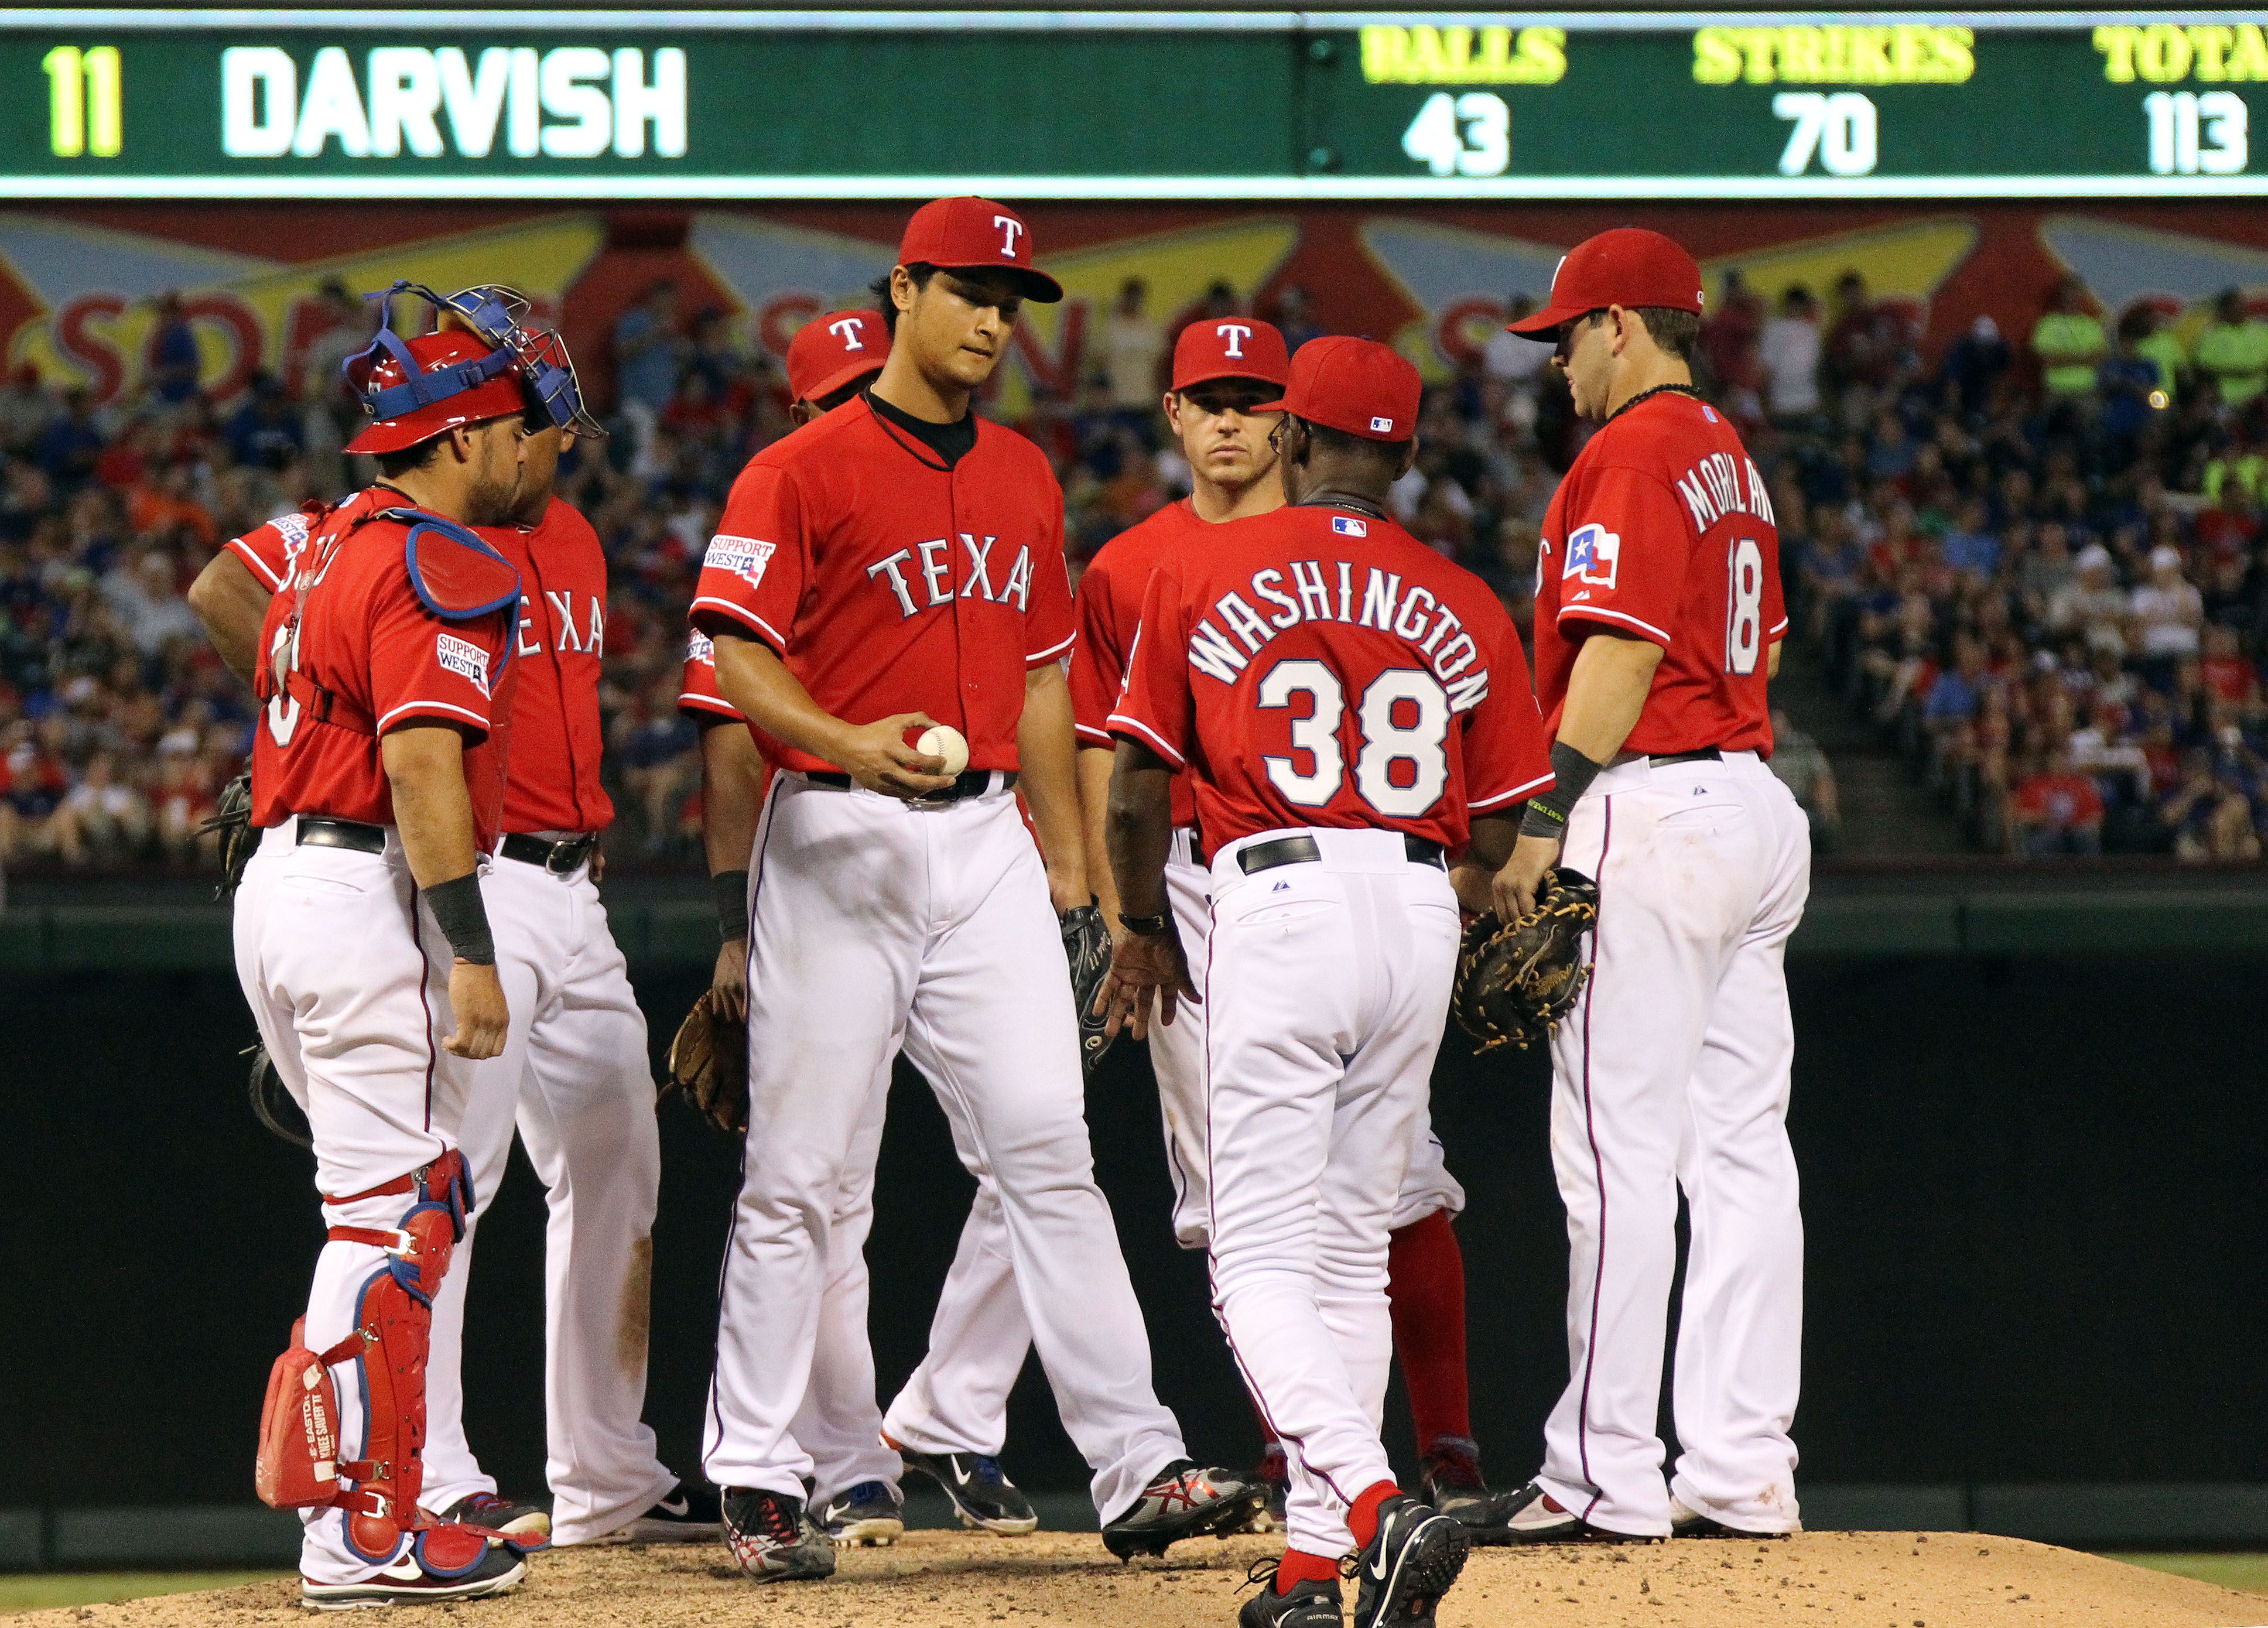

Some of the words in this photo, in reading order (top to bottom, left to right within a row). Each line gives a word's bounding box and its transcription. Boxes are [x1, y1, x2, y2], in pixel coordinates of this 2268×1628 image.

[1359, 24, 1568, 84] BALLS
[1692, 24, 1976, 84] STRIKES
[2093, 23, 2268, 83] TOTA
[40, 45, 122, 158] 11
[221, 46, 687, 158] DARVISH
[1401, 92, 1510, 176] 43
[1773, 92, 1878, 176] 70
[2142, 90, 2249, 175] 113
[994, 215, 1022, 259] T
[829, 318, 866, 352] T
[1217, 324, 1253, 359] T
[706, 552, 743, 567] WEST
[710, 537, 772, 558] SUPPORT
[867, 532, 1034, 618] TEXA
[1724, 536, 1763, 675] 18
[439, 636, 488, 668] SUPPORT
[1188, 560, 1489, 714] WASHINGTON
[439, 651, 473, 675] WEST
[1256, 659, 1449, 818] 38
[313, 1406, 328, 1435] SAVER
[317, 1435, 330, 1459] KNEE
